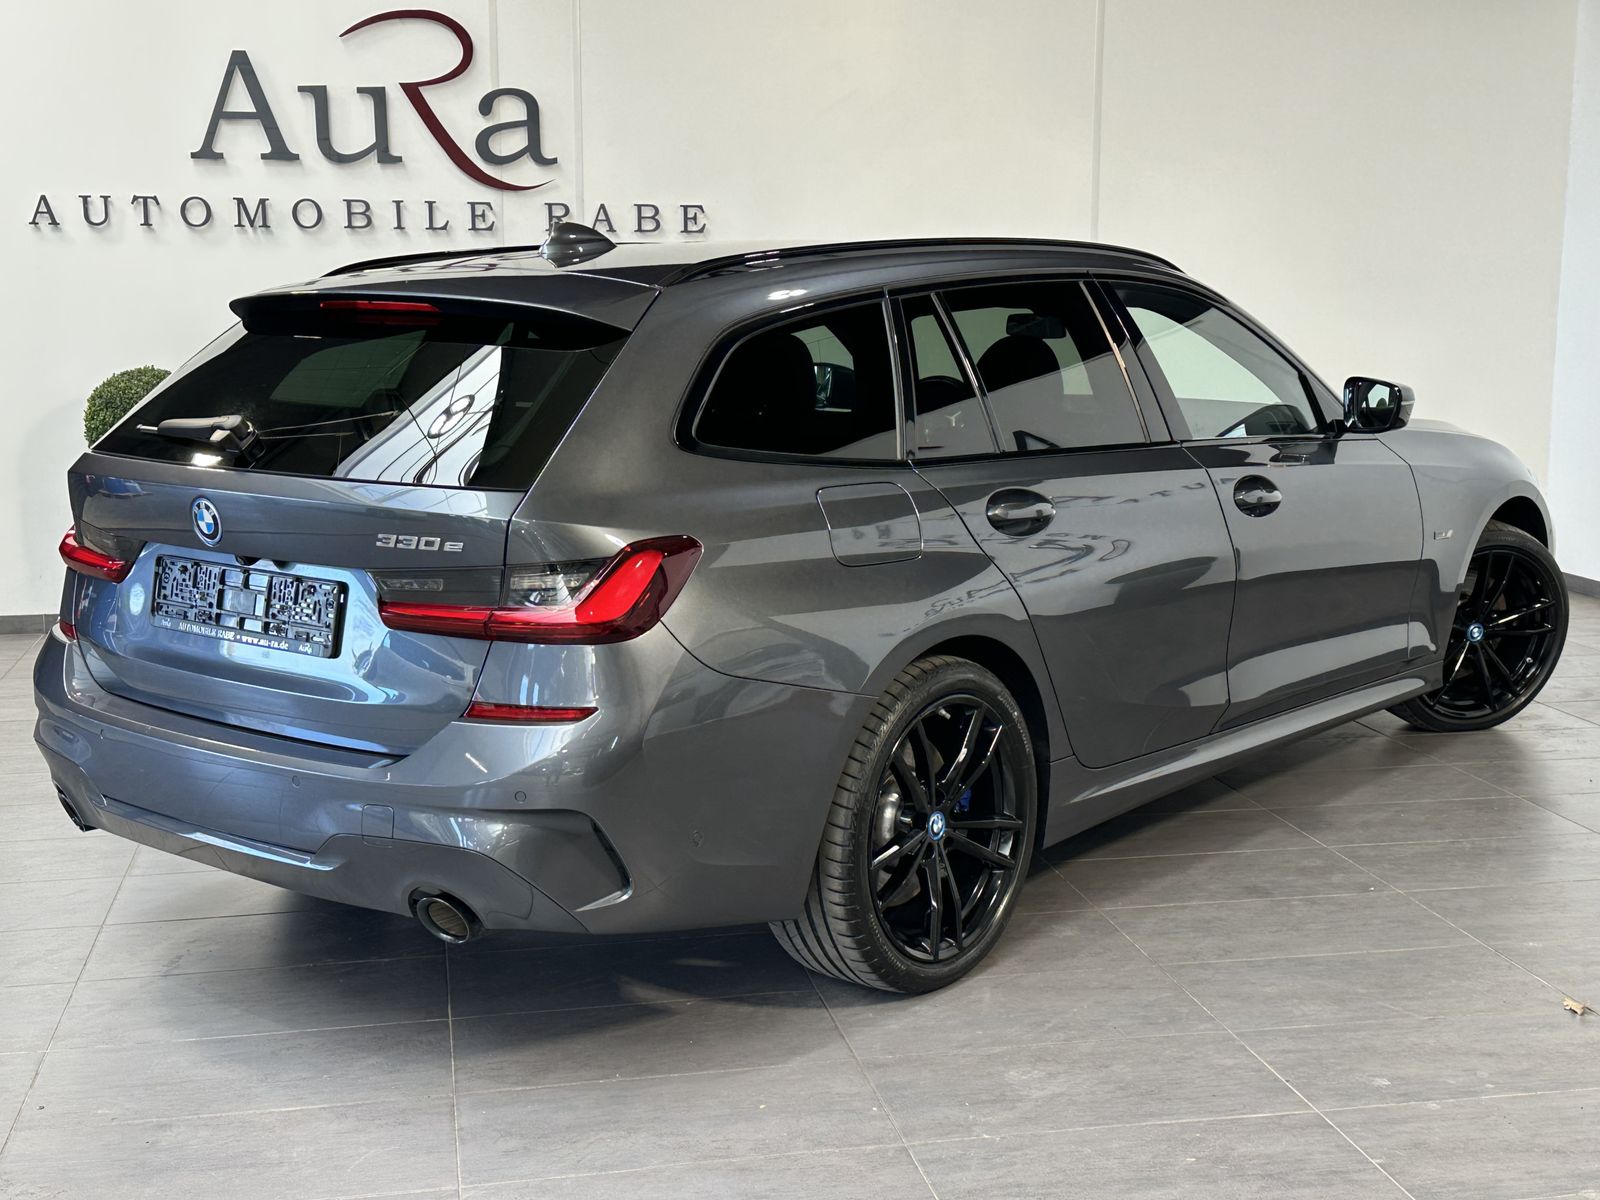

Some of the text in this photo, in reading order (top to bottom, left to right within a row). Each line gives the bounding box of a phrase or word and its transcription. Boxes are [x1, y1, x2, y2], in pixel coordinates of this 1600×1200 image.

[191, 9, 558, 193] AuRa
[29, 194, 708, 234] AUTOMOBILE RABE
